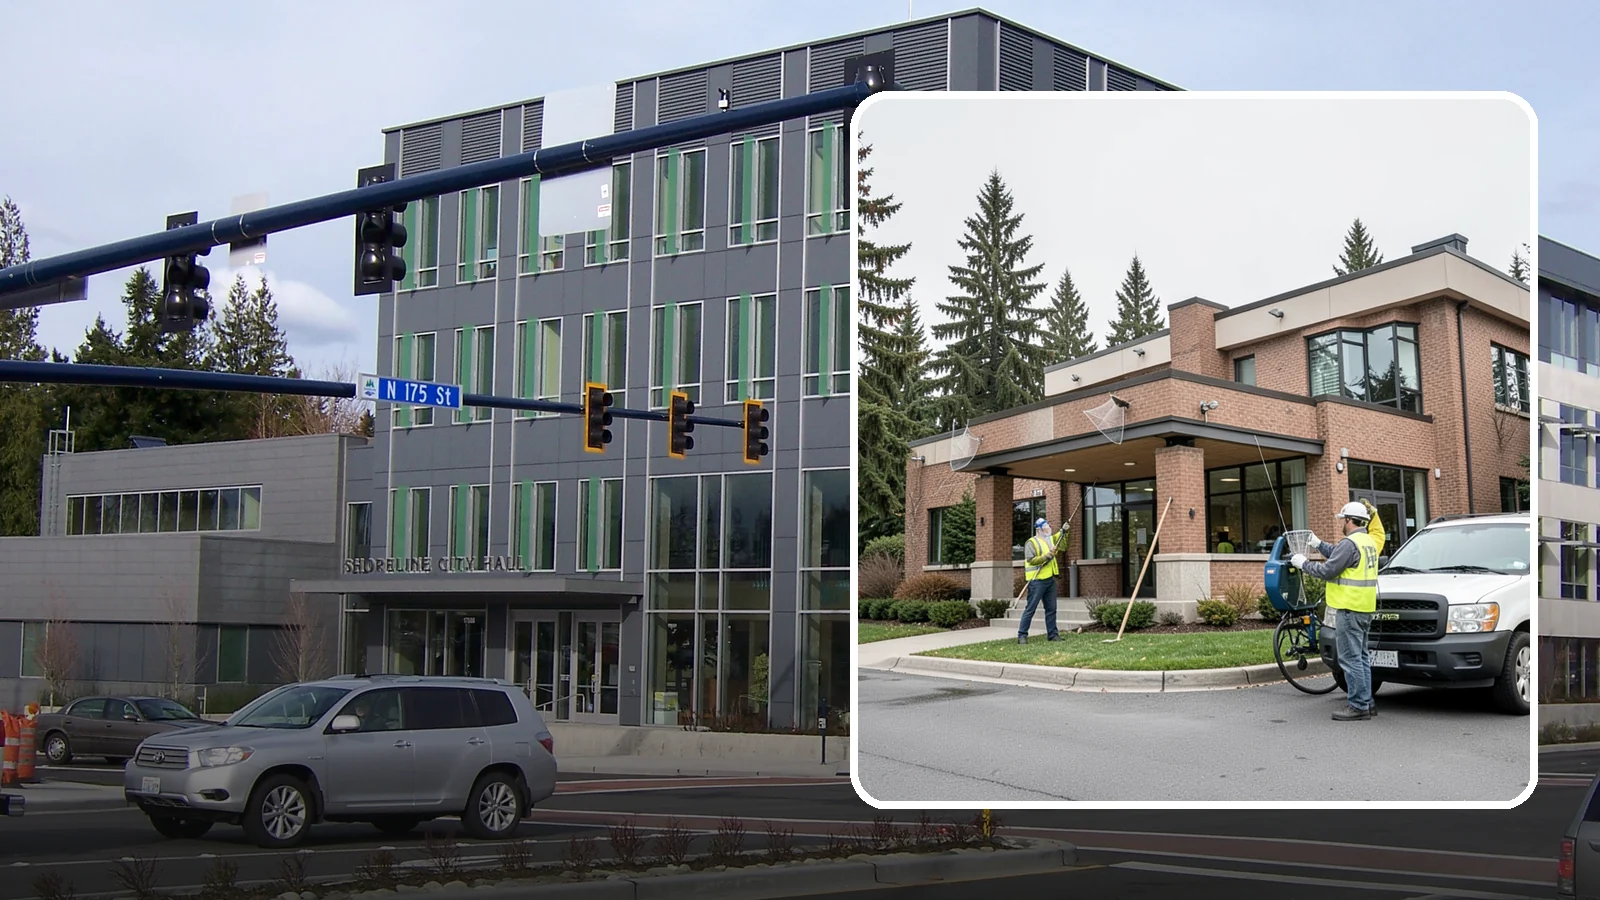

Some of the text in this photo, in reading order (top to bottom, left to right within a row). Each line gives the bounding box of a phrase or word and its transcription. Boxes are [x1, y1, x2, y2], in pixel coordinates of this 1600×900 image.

[387, 381, 451, 406] N 175 St
[344, 555, 526, 574] SHORELINE CITY HALL
